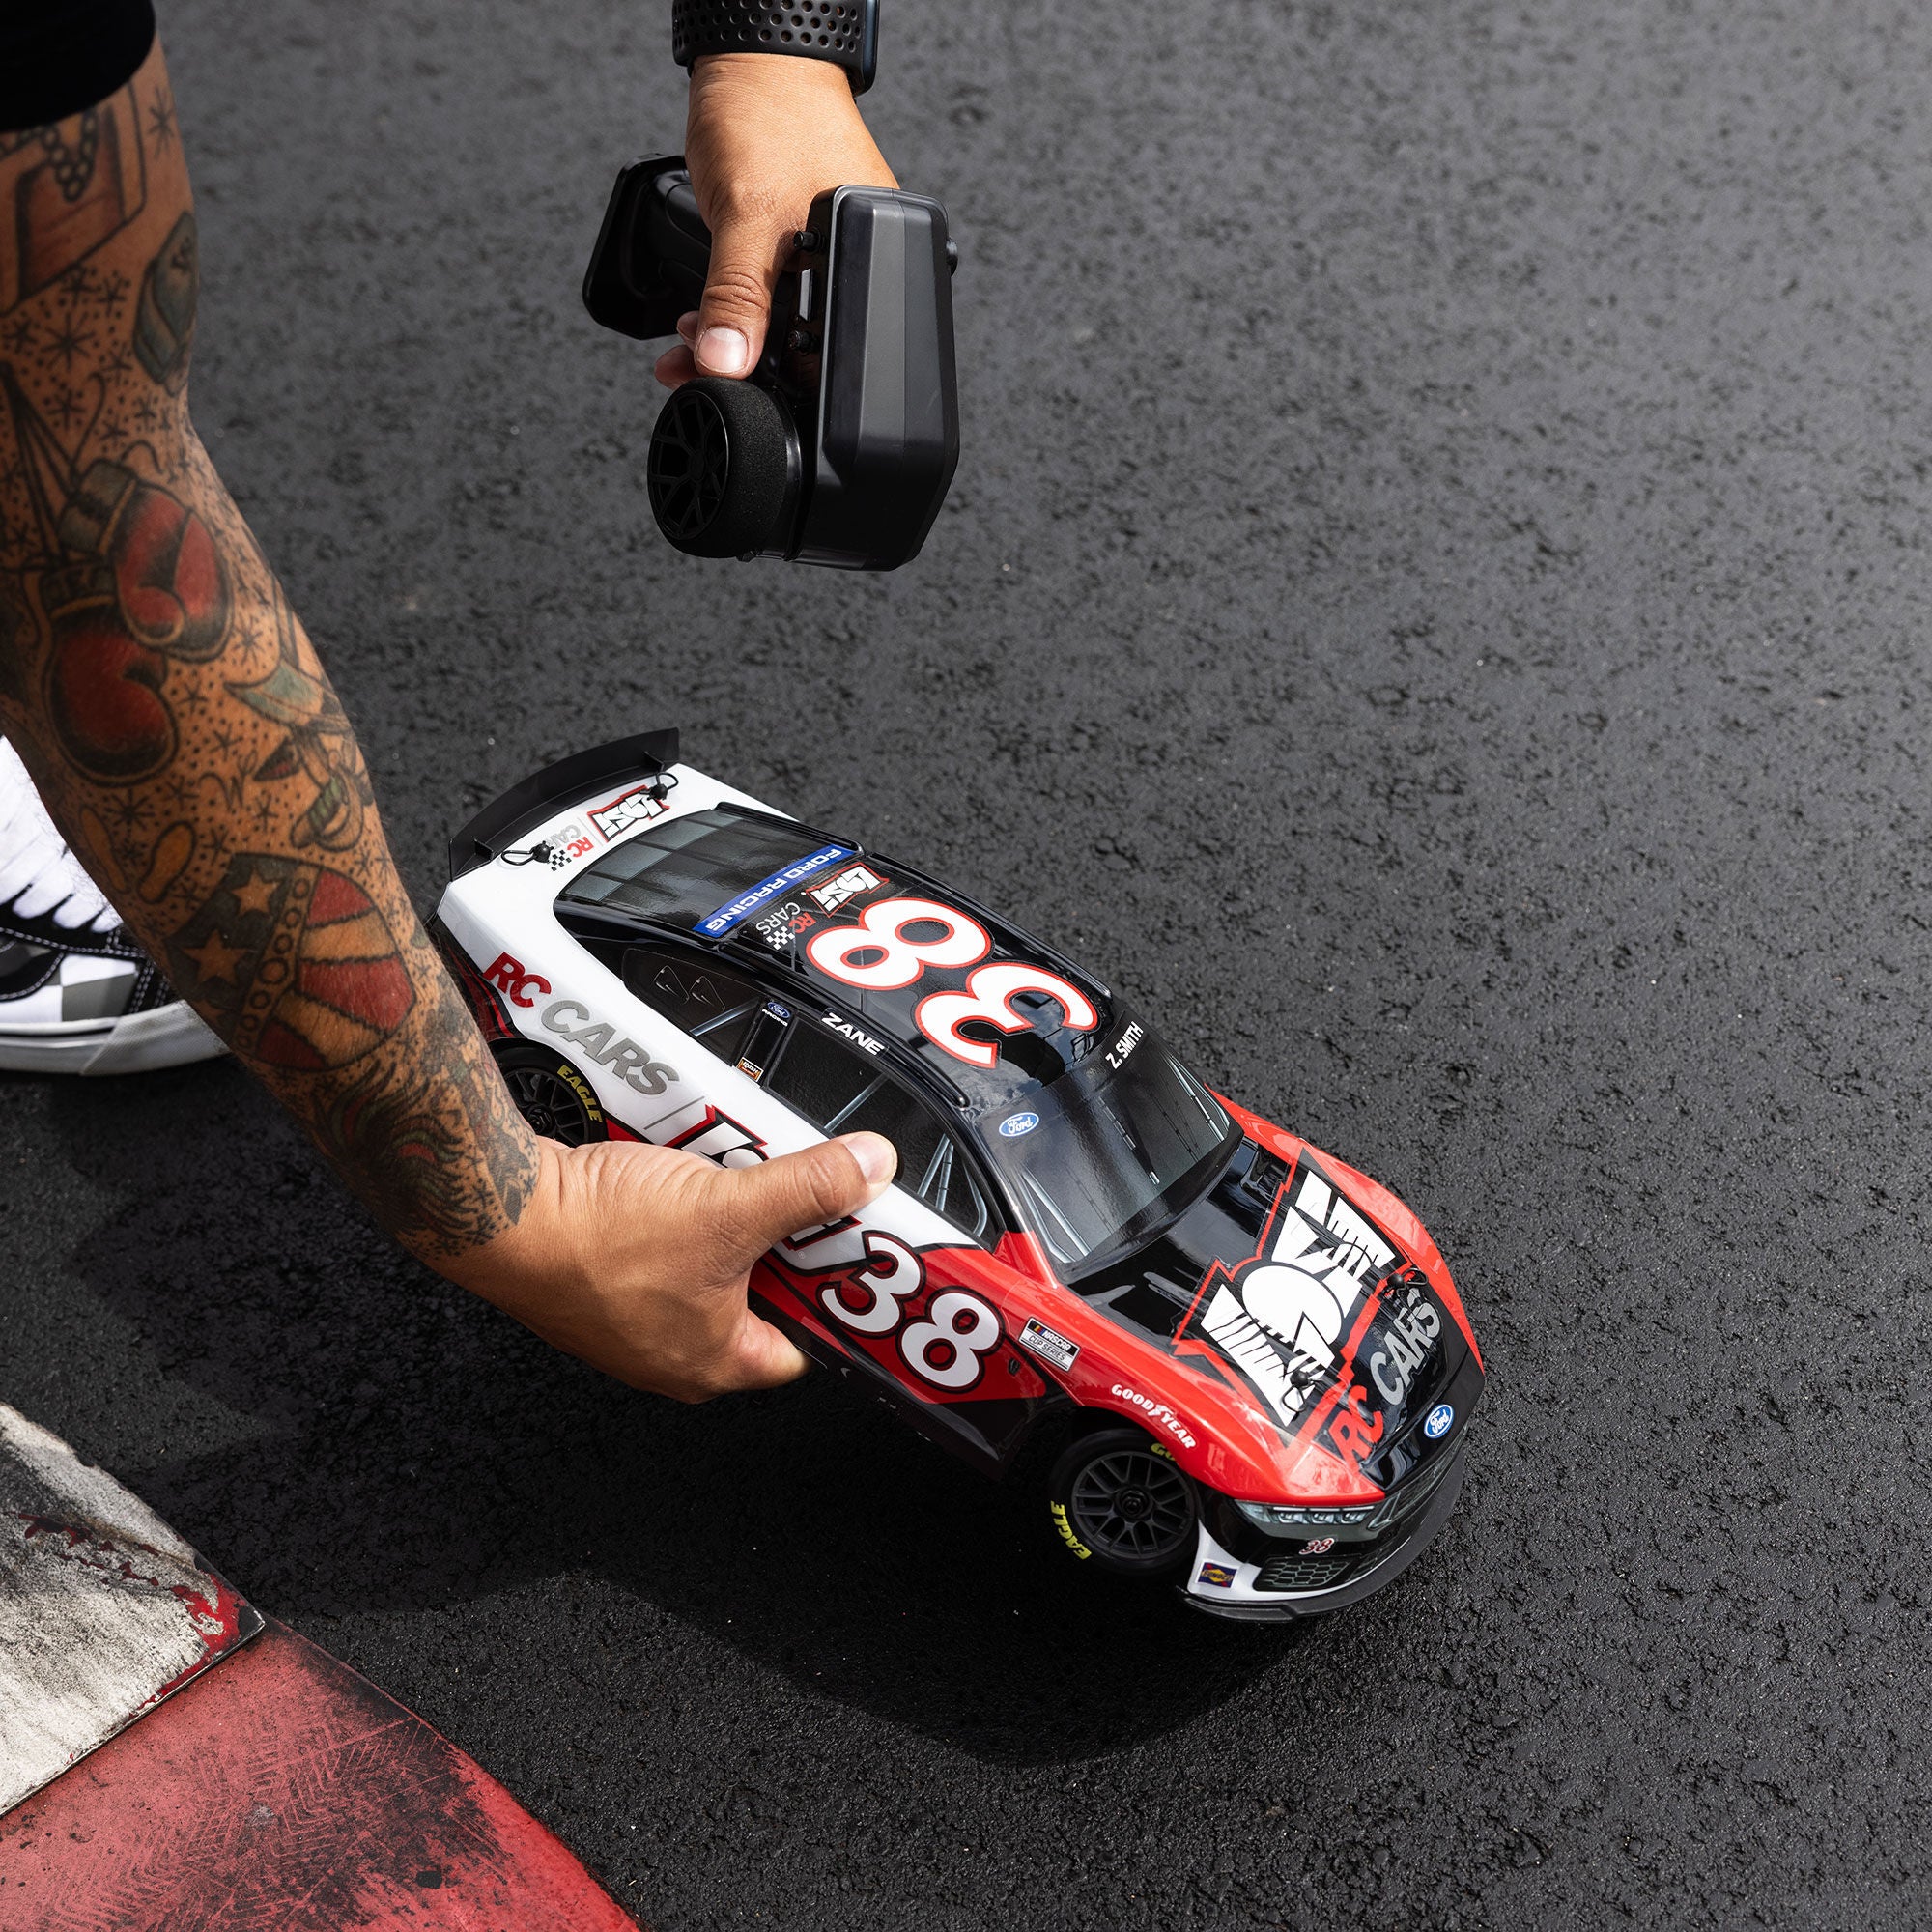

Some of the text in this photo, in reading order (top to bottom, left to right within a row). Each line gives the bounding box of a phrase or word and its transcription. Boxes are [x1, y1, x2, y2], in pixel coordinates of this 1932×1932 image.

[547, 825, 582, 849] CAR
[567, 837, 594, 858] RC
[705, 848, 842, 931] FORD RACING
[755, 901, 801, 935] CARS
[788, 912, 817, 933] RC
[806, 897, 1098, 1069] 38
[482, 952, 680, 1095] RC CARS
[821, 1012, 885, 1056] ZANE
[1105, 1021, 1144, 1069] Z. SMITH
[556, 1065, 603, 1122] EAGLE
[1005, 1114, 1036, 1135] Ford
[819, 1234, 1003, 1390] 38
[1028, 1335, 1066, 1361] CUP SERIES
[1042, 1330, 1071, 1351] NASCAR
[1328, 1288, 1440, 1472] RC CARS
[1111, 1383, 1197, 1449] GOODYEAR
[1429, 1406, 1451, 1435] Ford
[1050, 1500, 1092, 1560] EAGLE
[1298, 1537, 1335, 1555] 38
